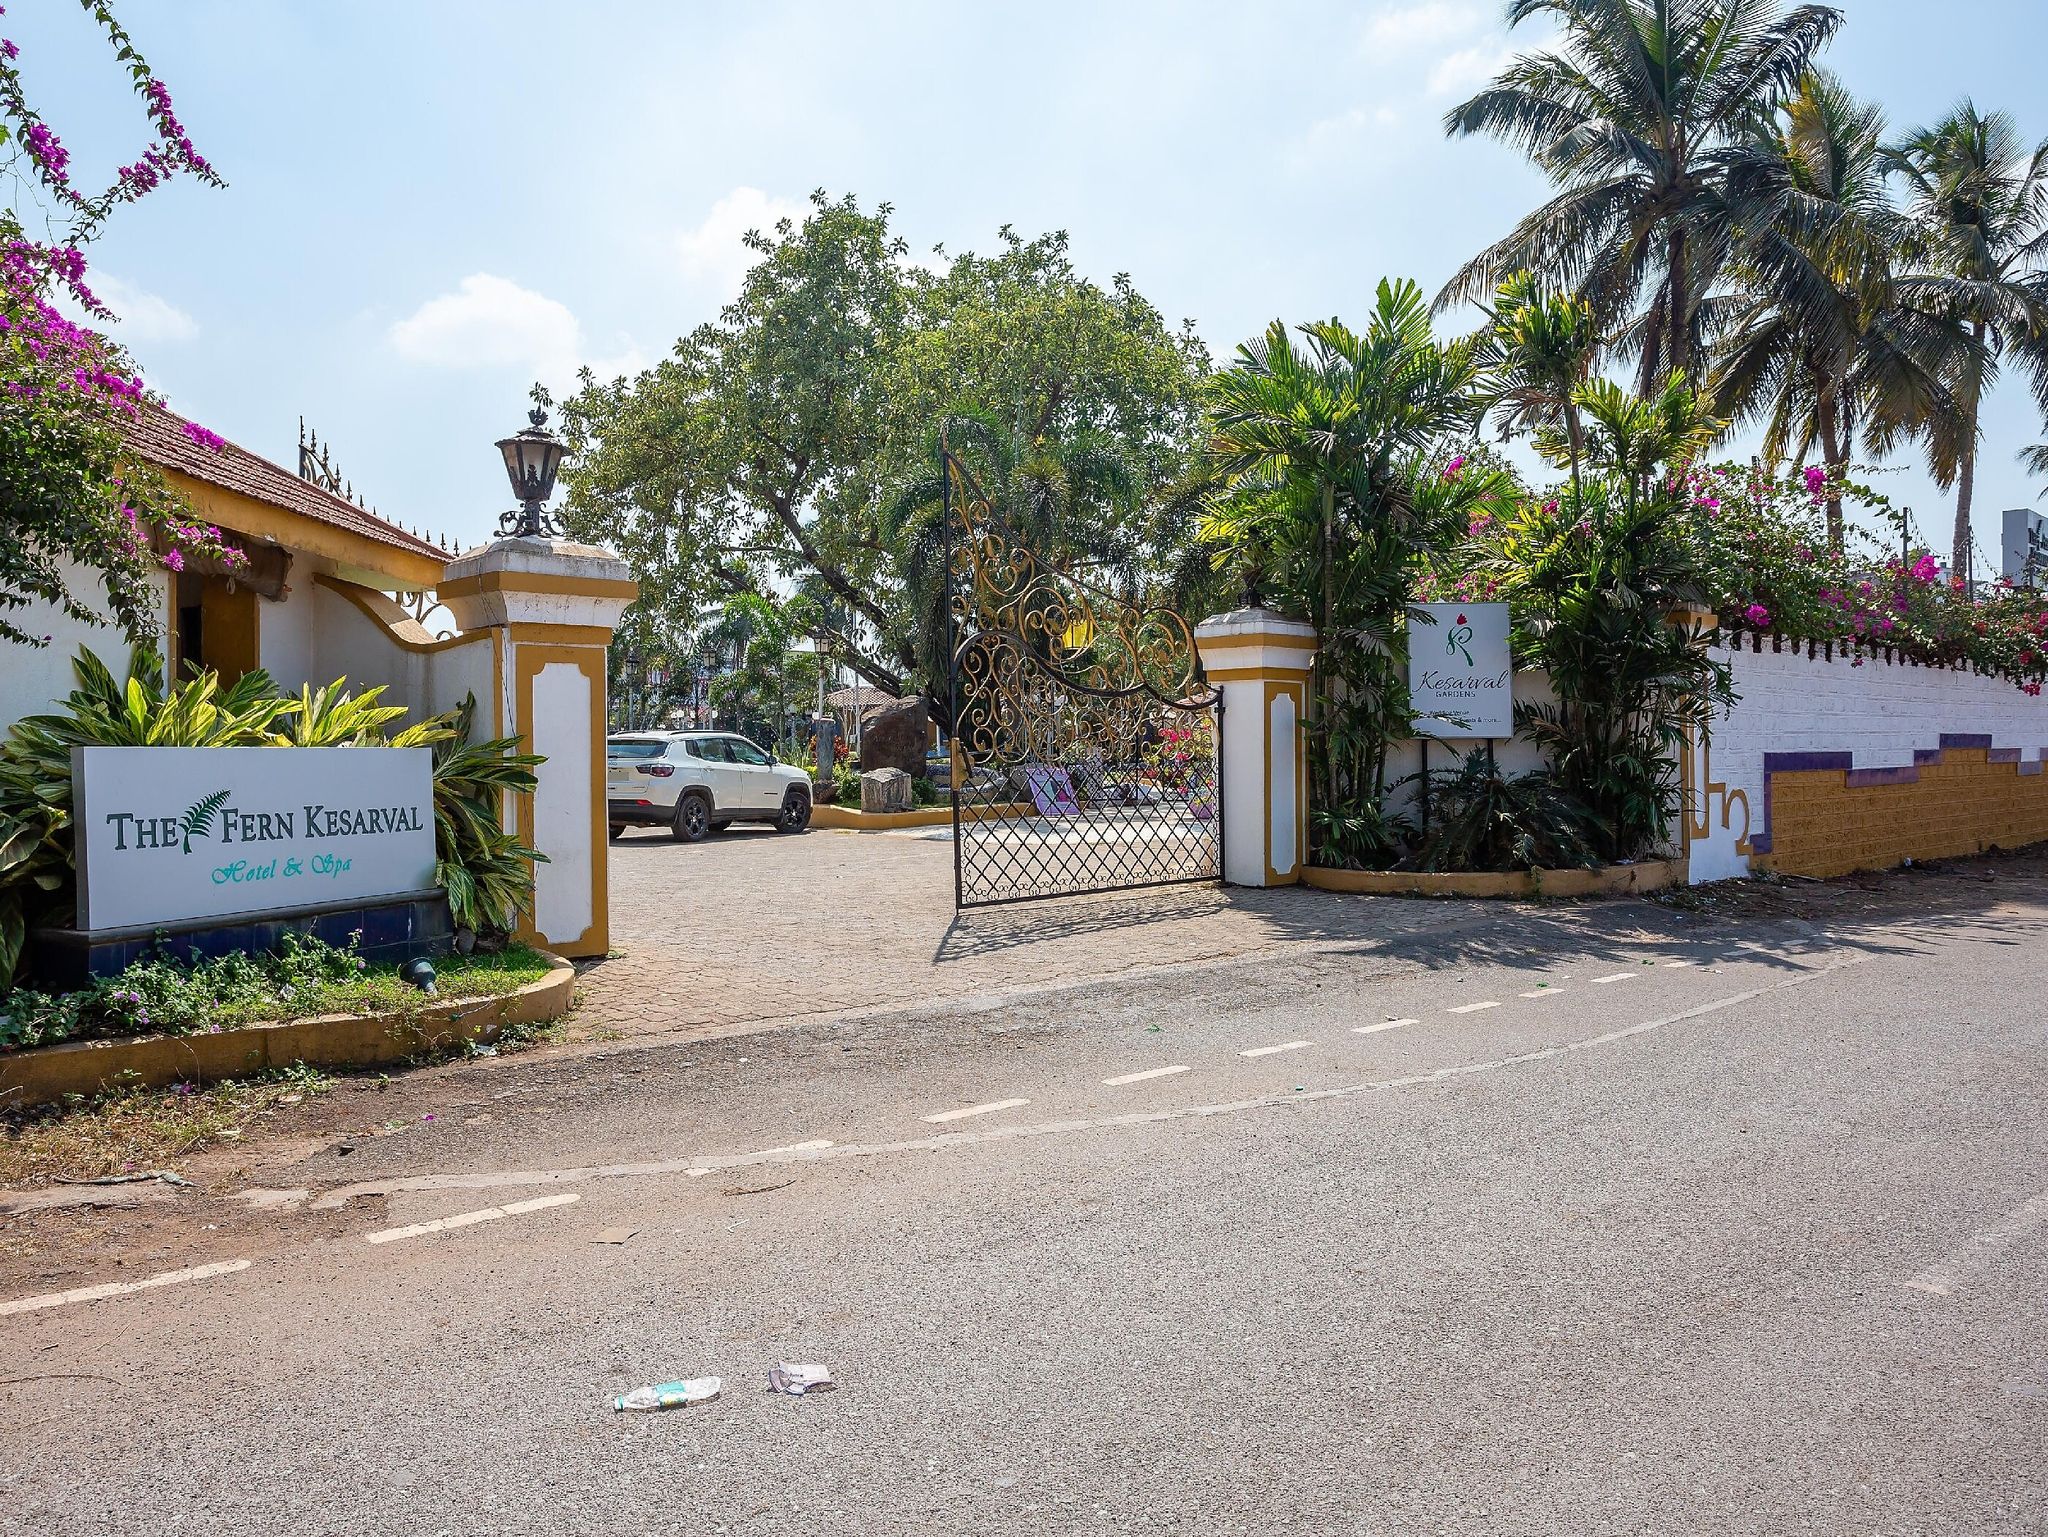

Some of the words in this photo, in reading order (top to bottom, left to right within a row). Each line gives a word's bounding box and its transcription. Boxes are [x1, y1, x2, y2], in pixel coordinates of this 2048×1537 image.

[1412, 670, 1508, 692] Kesarval
[107, 813, 178, 850] THE
[221, 808, 294, 842] FERN
[304, 805, 424, 838] KESARVAL
[211, 859, 277, 884] Hotel
[283, 858, 303, 876] &
[312, 853, 352, 879] Spa
